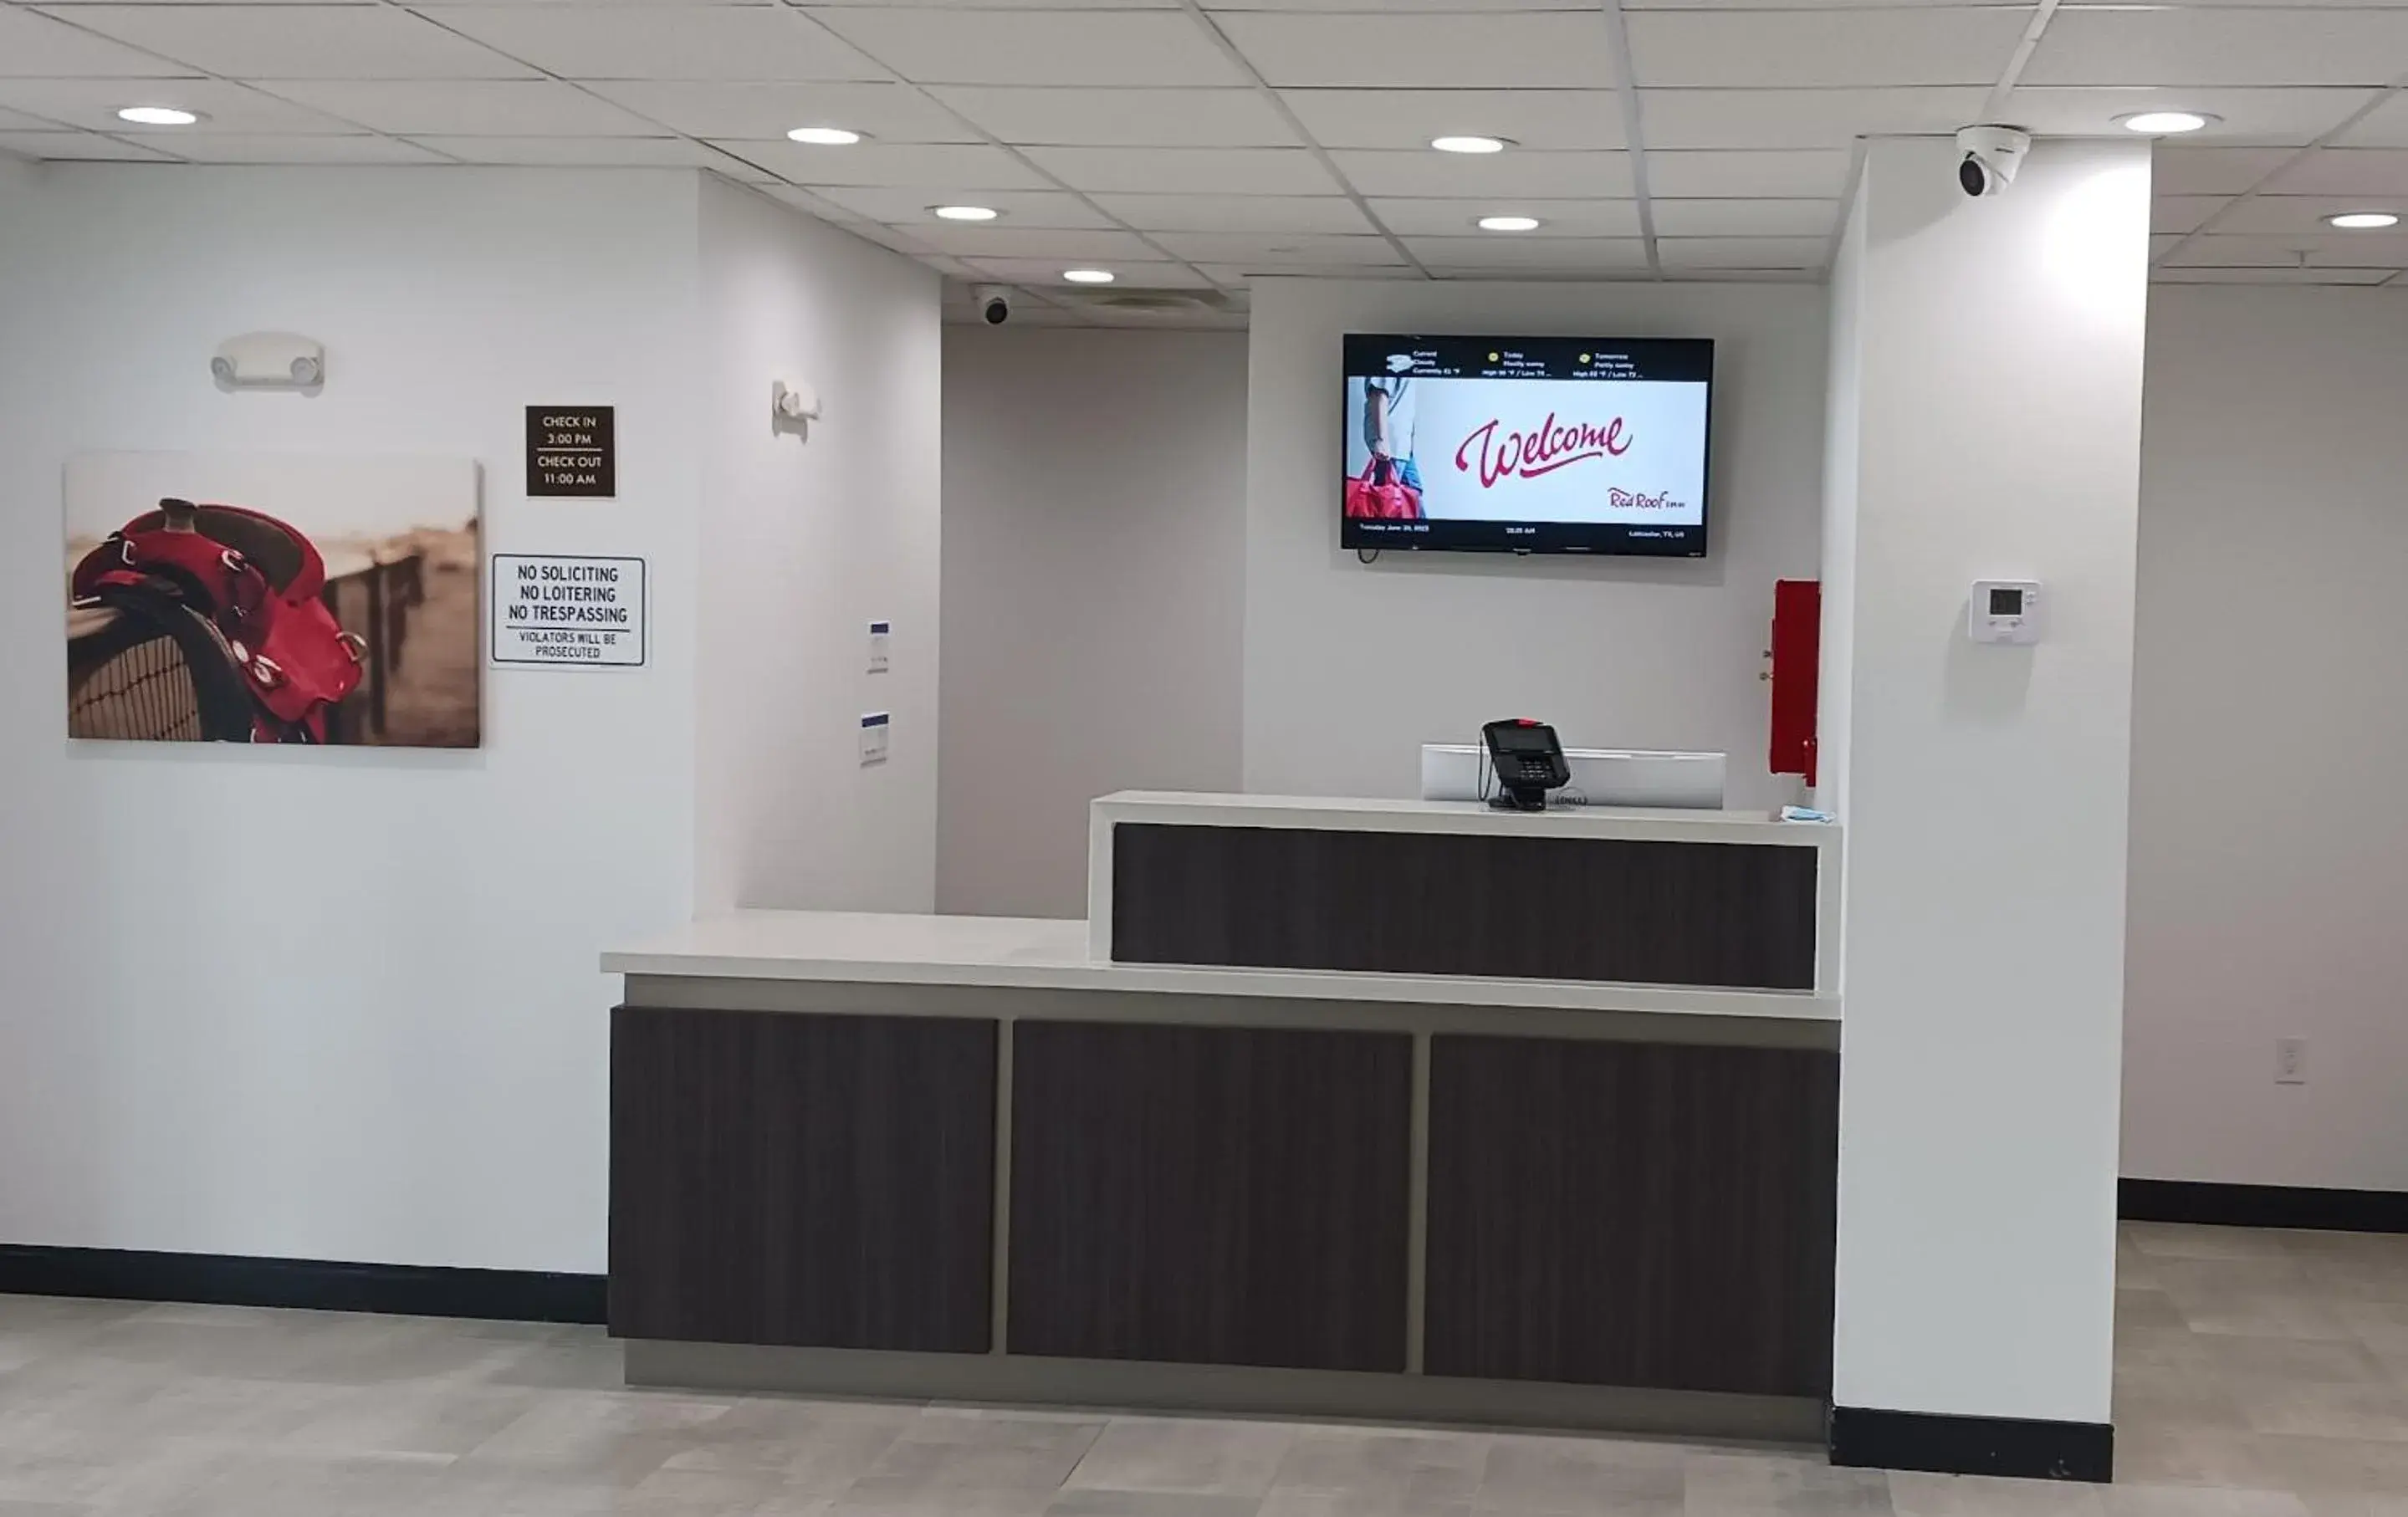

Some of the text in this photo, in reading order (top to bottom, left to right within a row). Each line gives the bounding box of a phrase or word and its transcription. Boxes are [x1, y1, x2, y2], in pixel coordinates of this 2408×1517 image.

[543, 416, 596, 427] CHECK IN
[575, 433, 591, 444] PM
[1455, 412, 1633, 488] Welcome
[538, 456, 601, 467] CHECK OUT
[544, 473, 596, 484] 11:00 AM
[1608, 490, 1633, 508] Red
[1636, 490, 1669, 509] Roof
[518, 565, 619, 582] NO SOLICITING
[520, 585, 616, 602] NO LOITERING
[509, 605, 627, 622] NO TRESPASSING
[519, 632, 616, 645] VIOLATORS WILL BE
[535, 646, 601, 658] PROSECUTED
